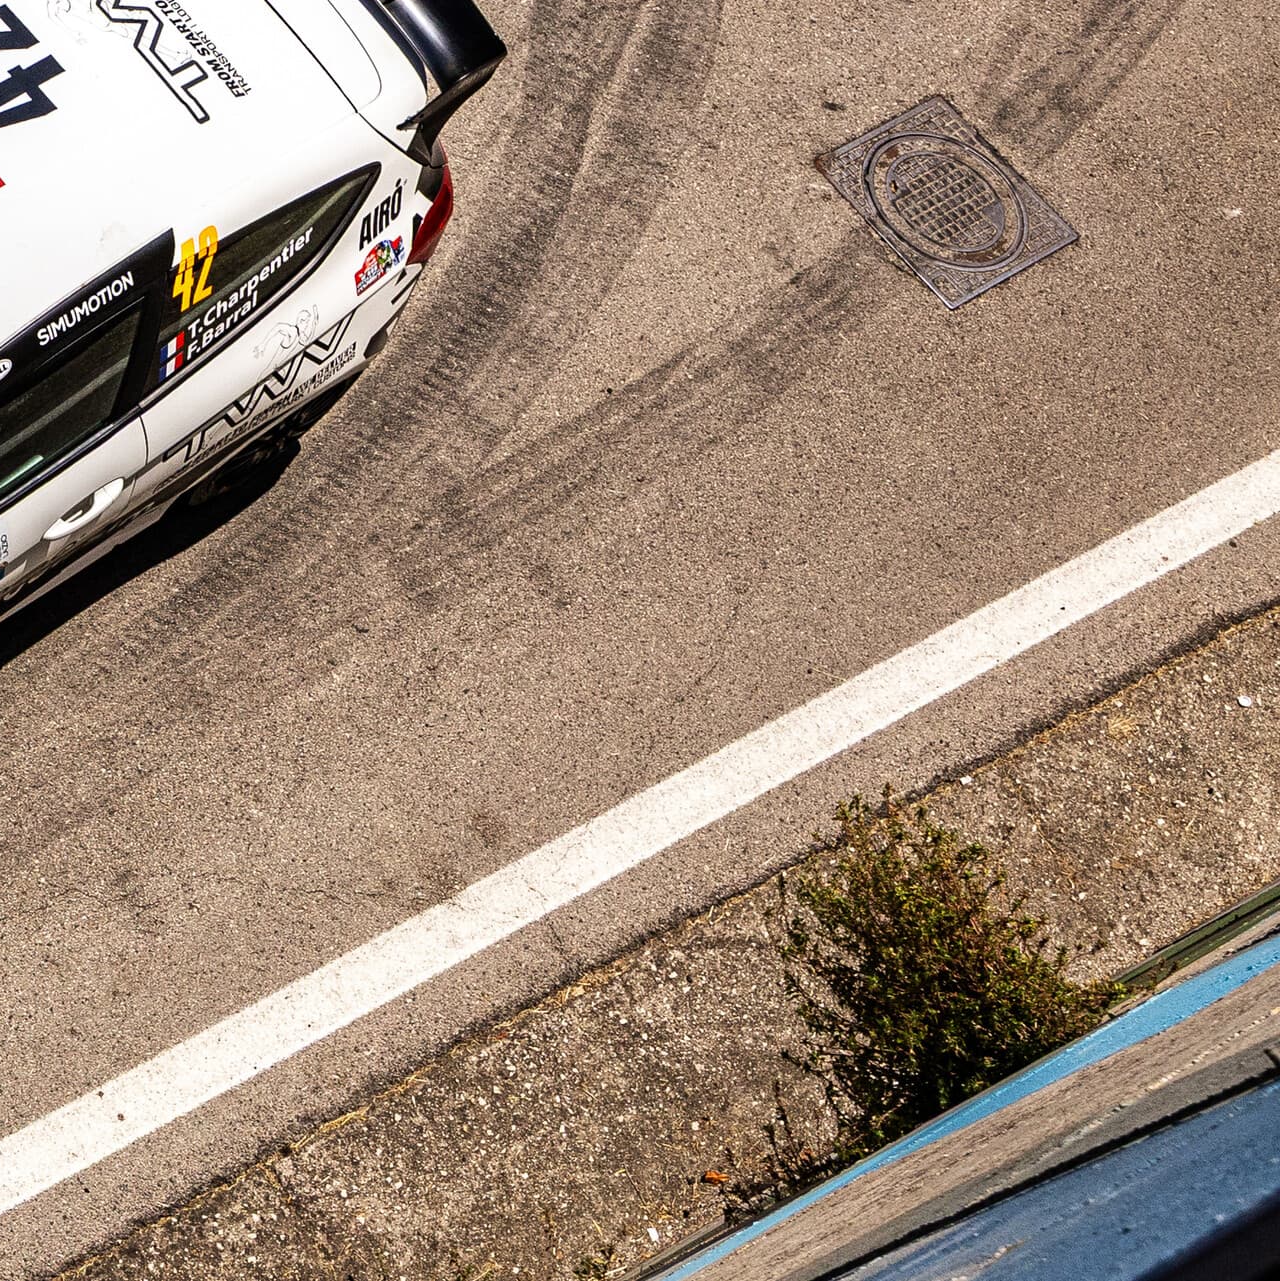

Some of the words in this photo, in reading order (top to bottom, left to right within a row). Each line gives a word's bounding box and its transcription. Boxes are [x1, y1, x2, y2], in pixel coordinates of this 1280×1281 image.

[169, 15, 210, 56] START
[194, 28, 252, 94] TRANSPORT
[205, 57, 246, 98] FROM
[172, 225, 219, 312] 42
[37, 272, 134, 346] SIMUMOTION
[187, 292, 258, 361] F.Barral
